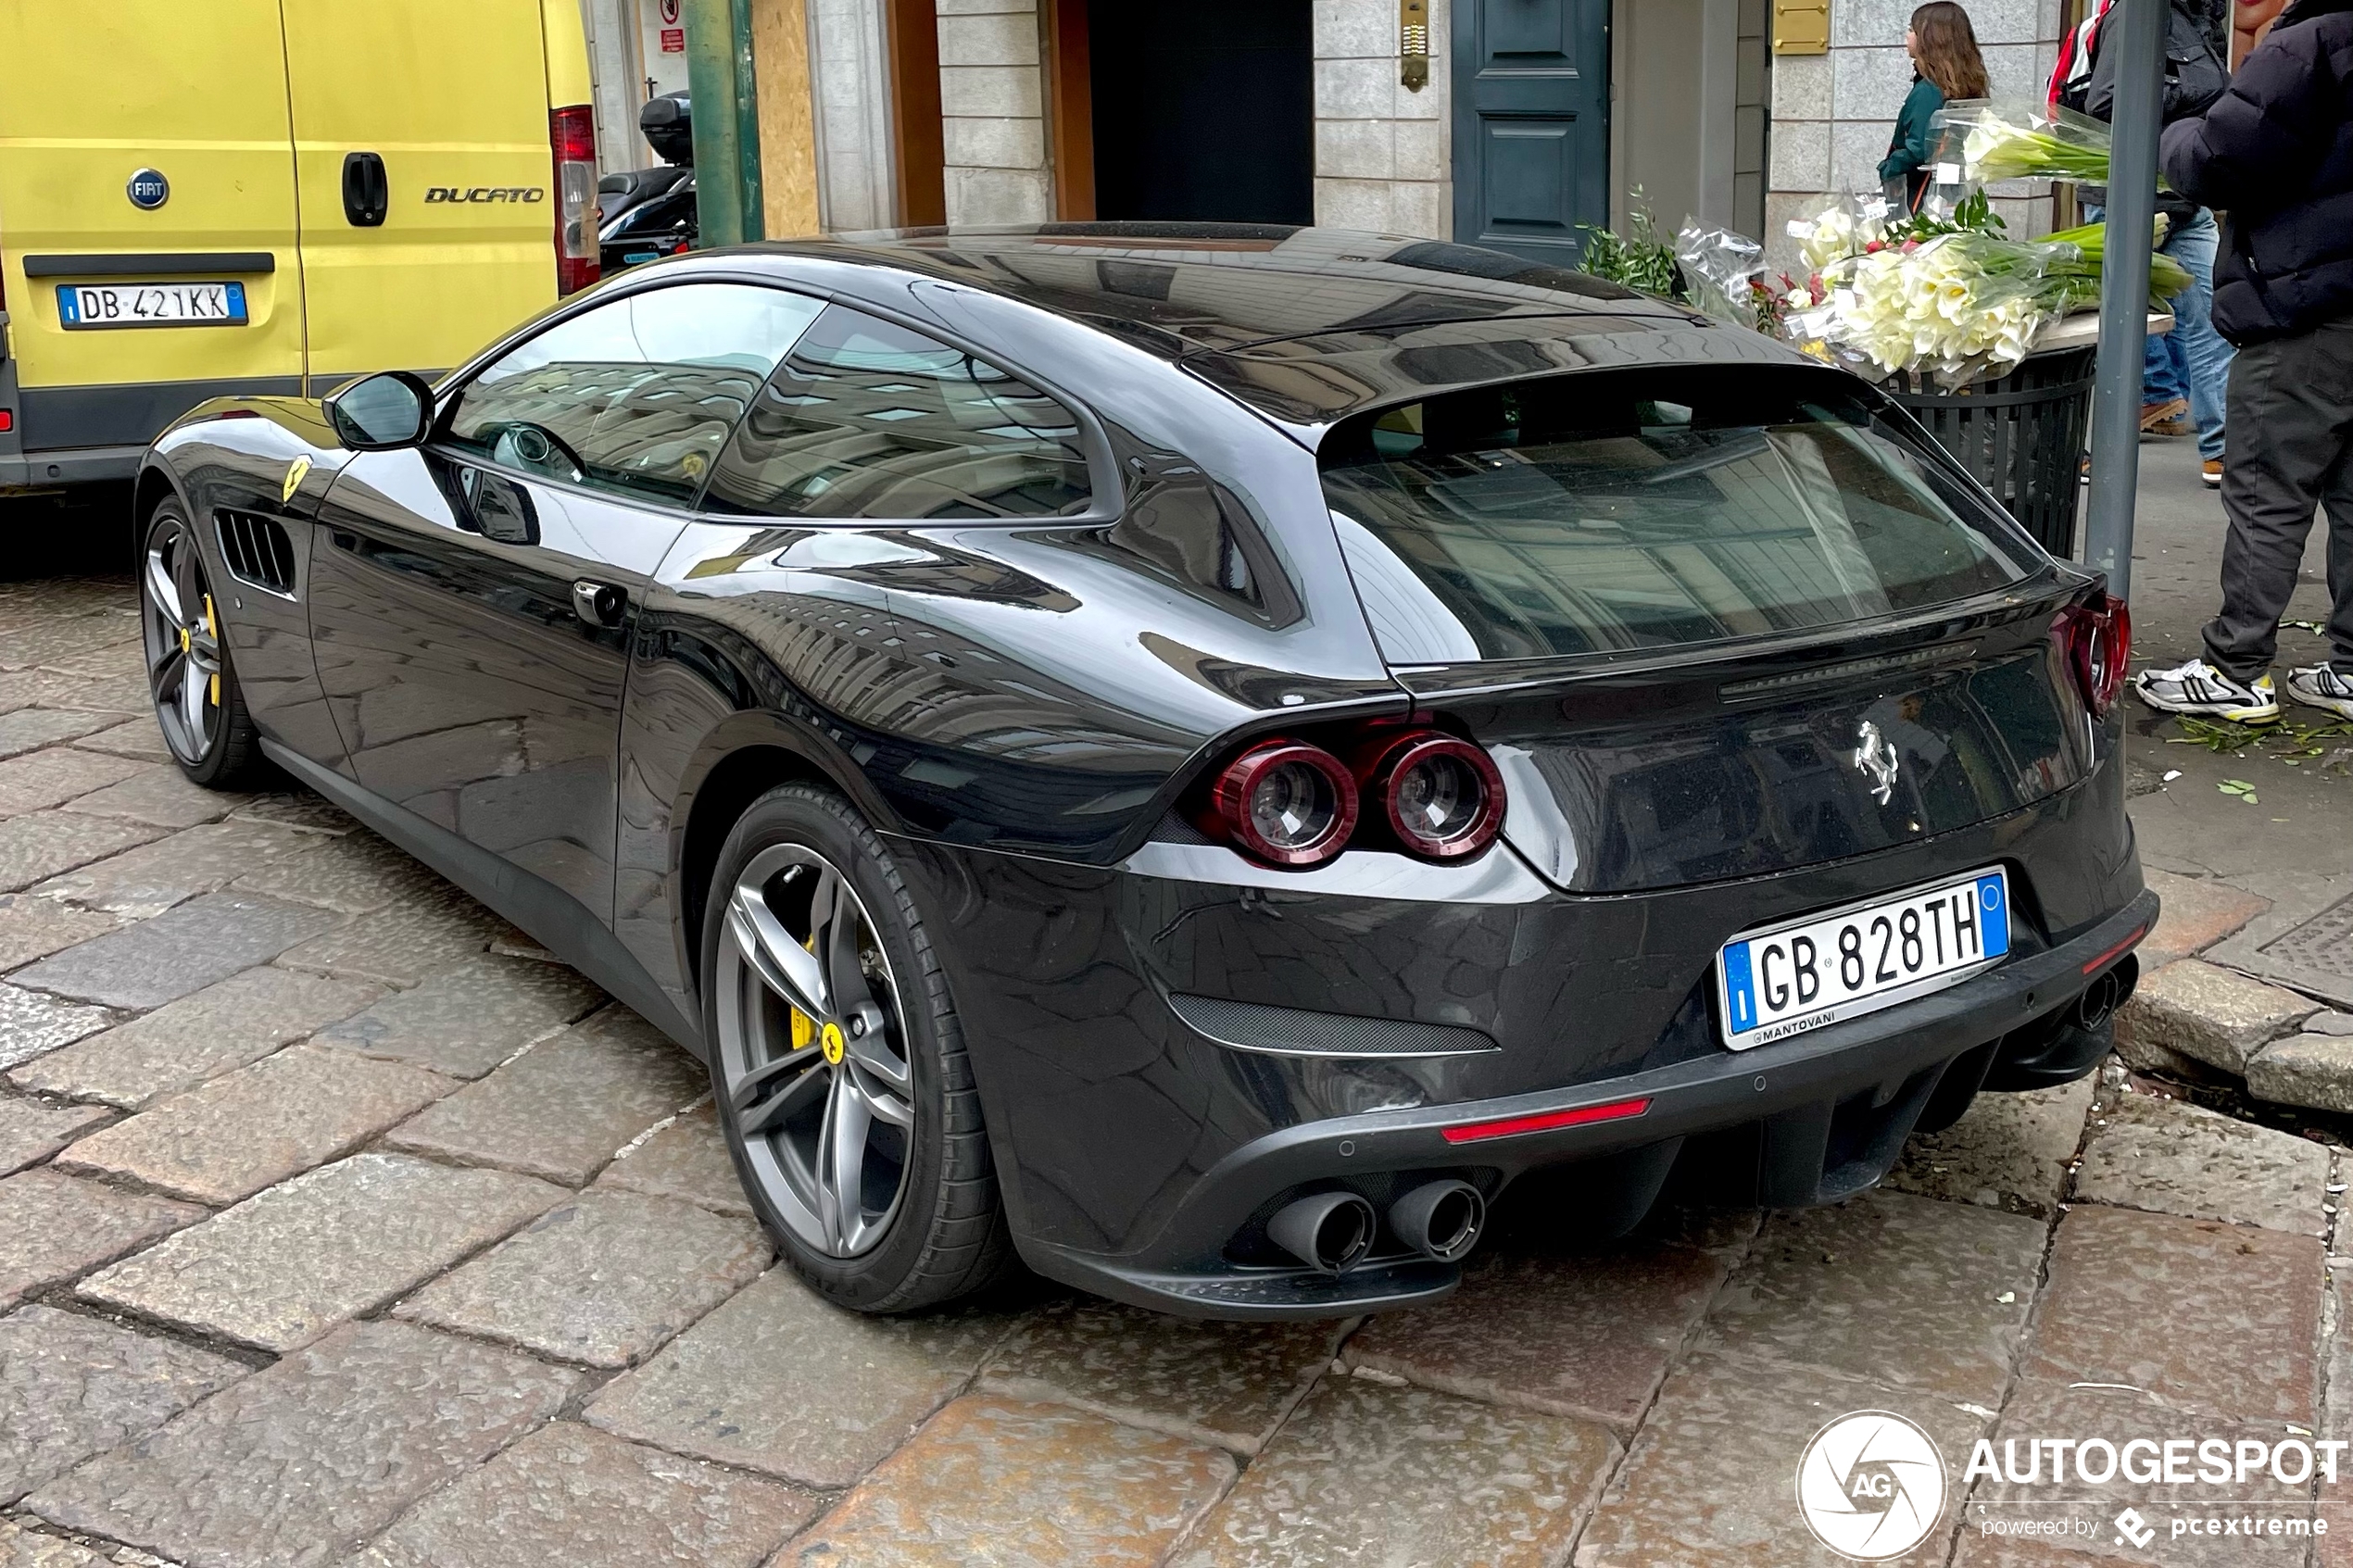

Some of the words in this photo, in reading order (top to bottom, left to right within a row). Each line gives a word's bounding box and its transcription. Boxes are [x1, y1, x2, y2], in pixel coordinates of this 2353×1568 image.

[134, 182, 163, 196] FIAT
[424, 187, 545, 204] DUCATO
[82, 290, 120, 320] DB
[133, 287, 226, 318] 421KK
[1760, 935, 1820, 1012] GB
[1838, 890, 1979, 992] 828TH
[1763, 1011, 1836, 1041] MANTOVANI
